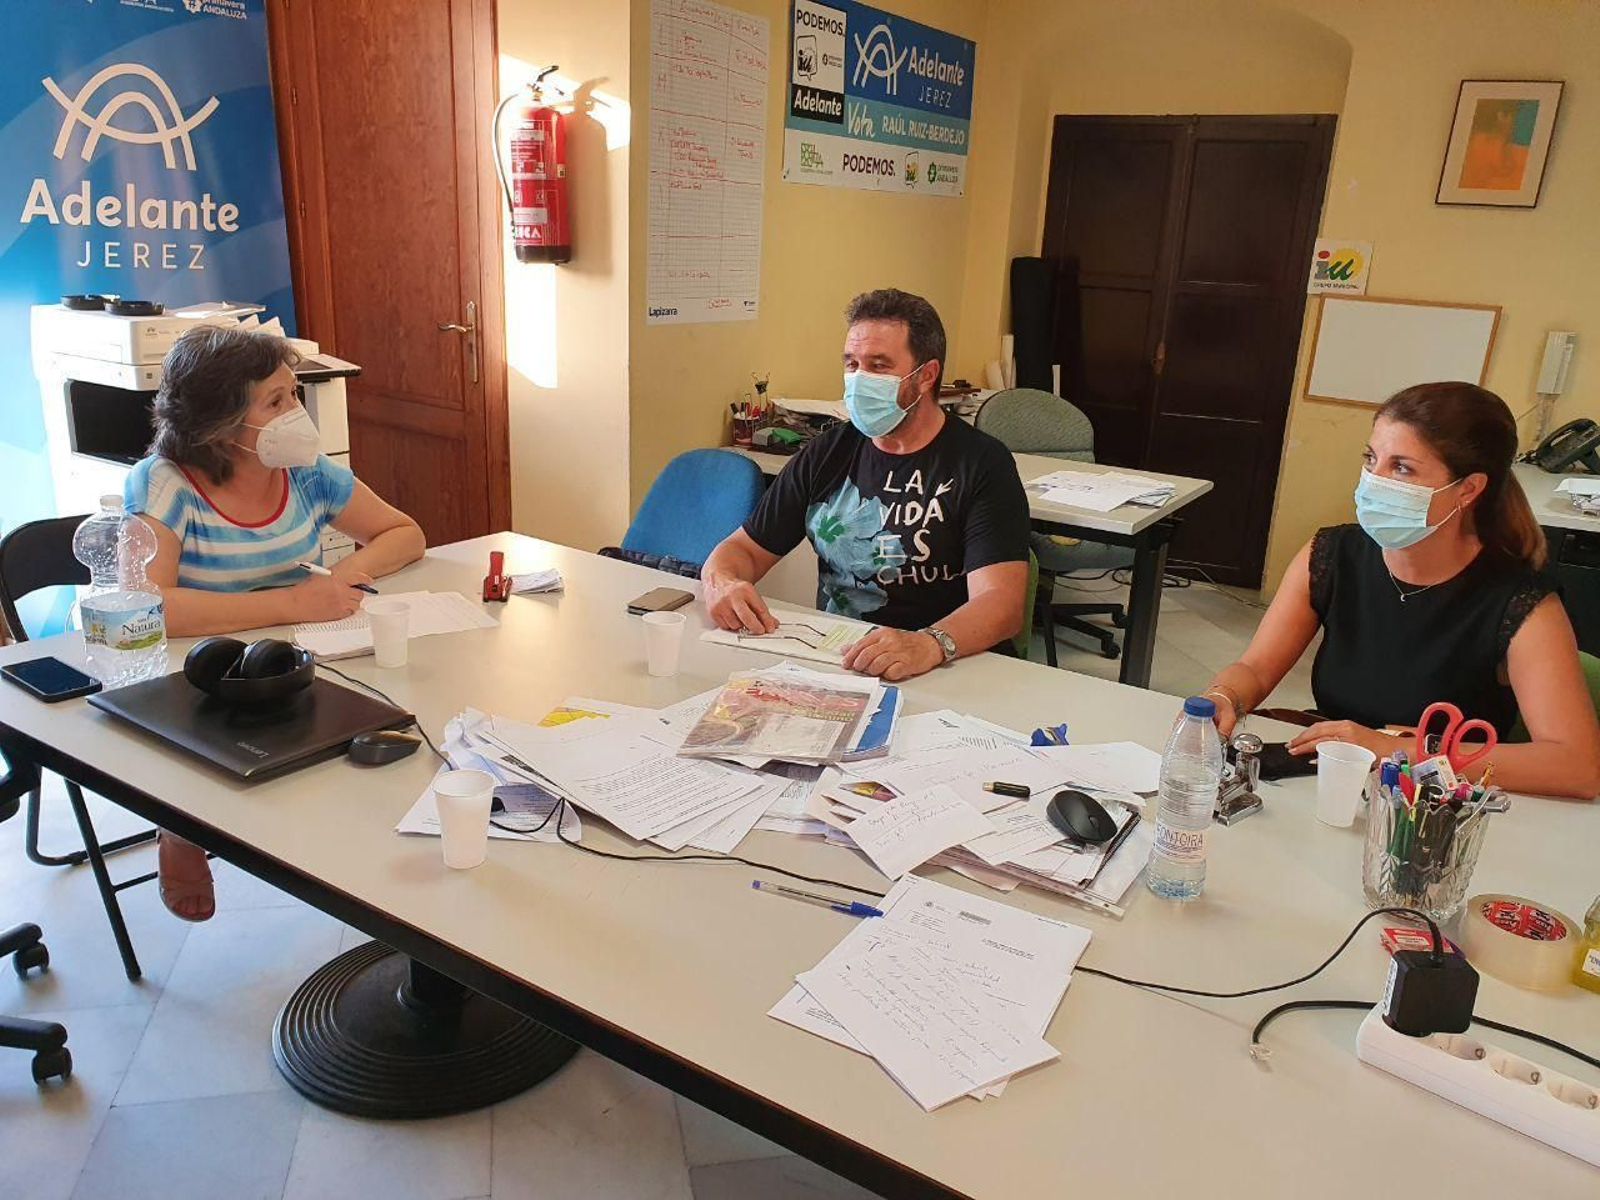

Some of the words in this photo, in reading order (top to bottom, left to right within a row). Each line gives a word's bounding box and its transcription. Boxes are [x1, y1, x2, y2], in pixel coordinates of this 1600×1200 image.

[203, 5, 247, 20] ANDALUZA
[796, 9, 845, 36] PODEMOS.
[908, 46, 965, 86] Adelante
[794, 90, 842, 116] Adelante
[918, 85, 952, 109] JEREZ
[847, 102, 876, 139] Vota
[881, 113, 907, 136] RAÚL
[909, 121, 965, 145] RUIZ-BERDEJO
[842, 153, 896, 177] PODEMOS.
[20, 178, 240, 233] Adelante
[76, 240, 205, 270] JEREZ
[649, 306, 678, 317] Lapizarra
[883, 469, 924, 495] LA
[879, 497, 945, 529] VIDA
[877, 529, 931, 562] ES
[876, 564, 962, 586] CHUL
